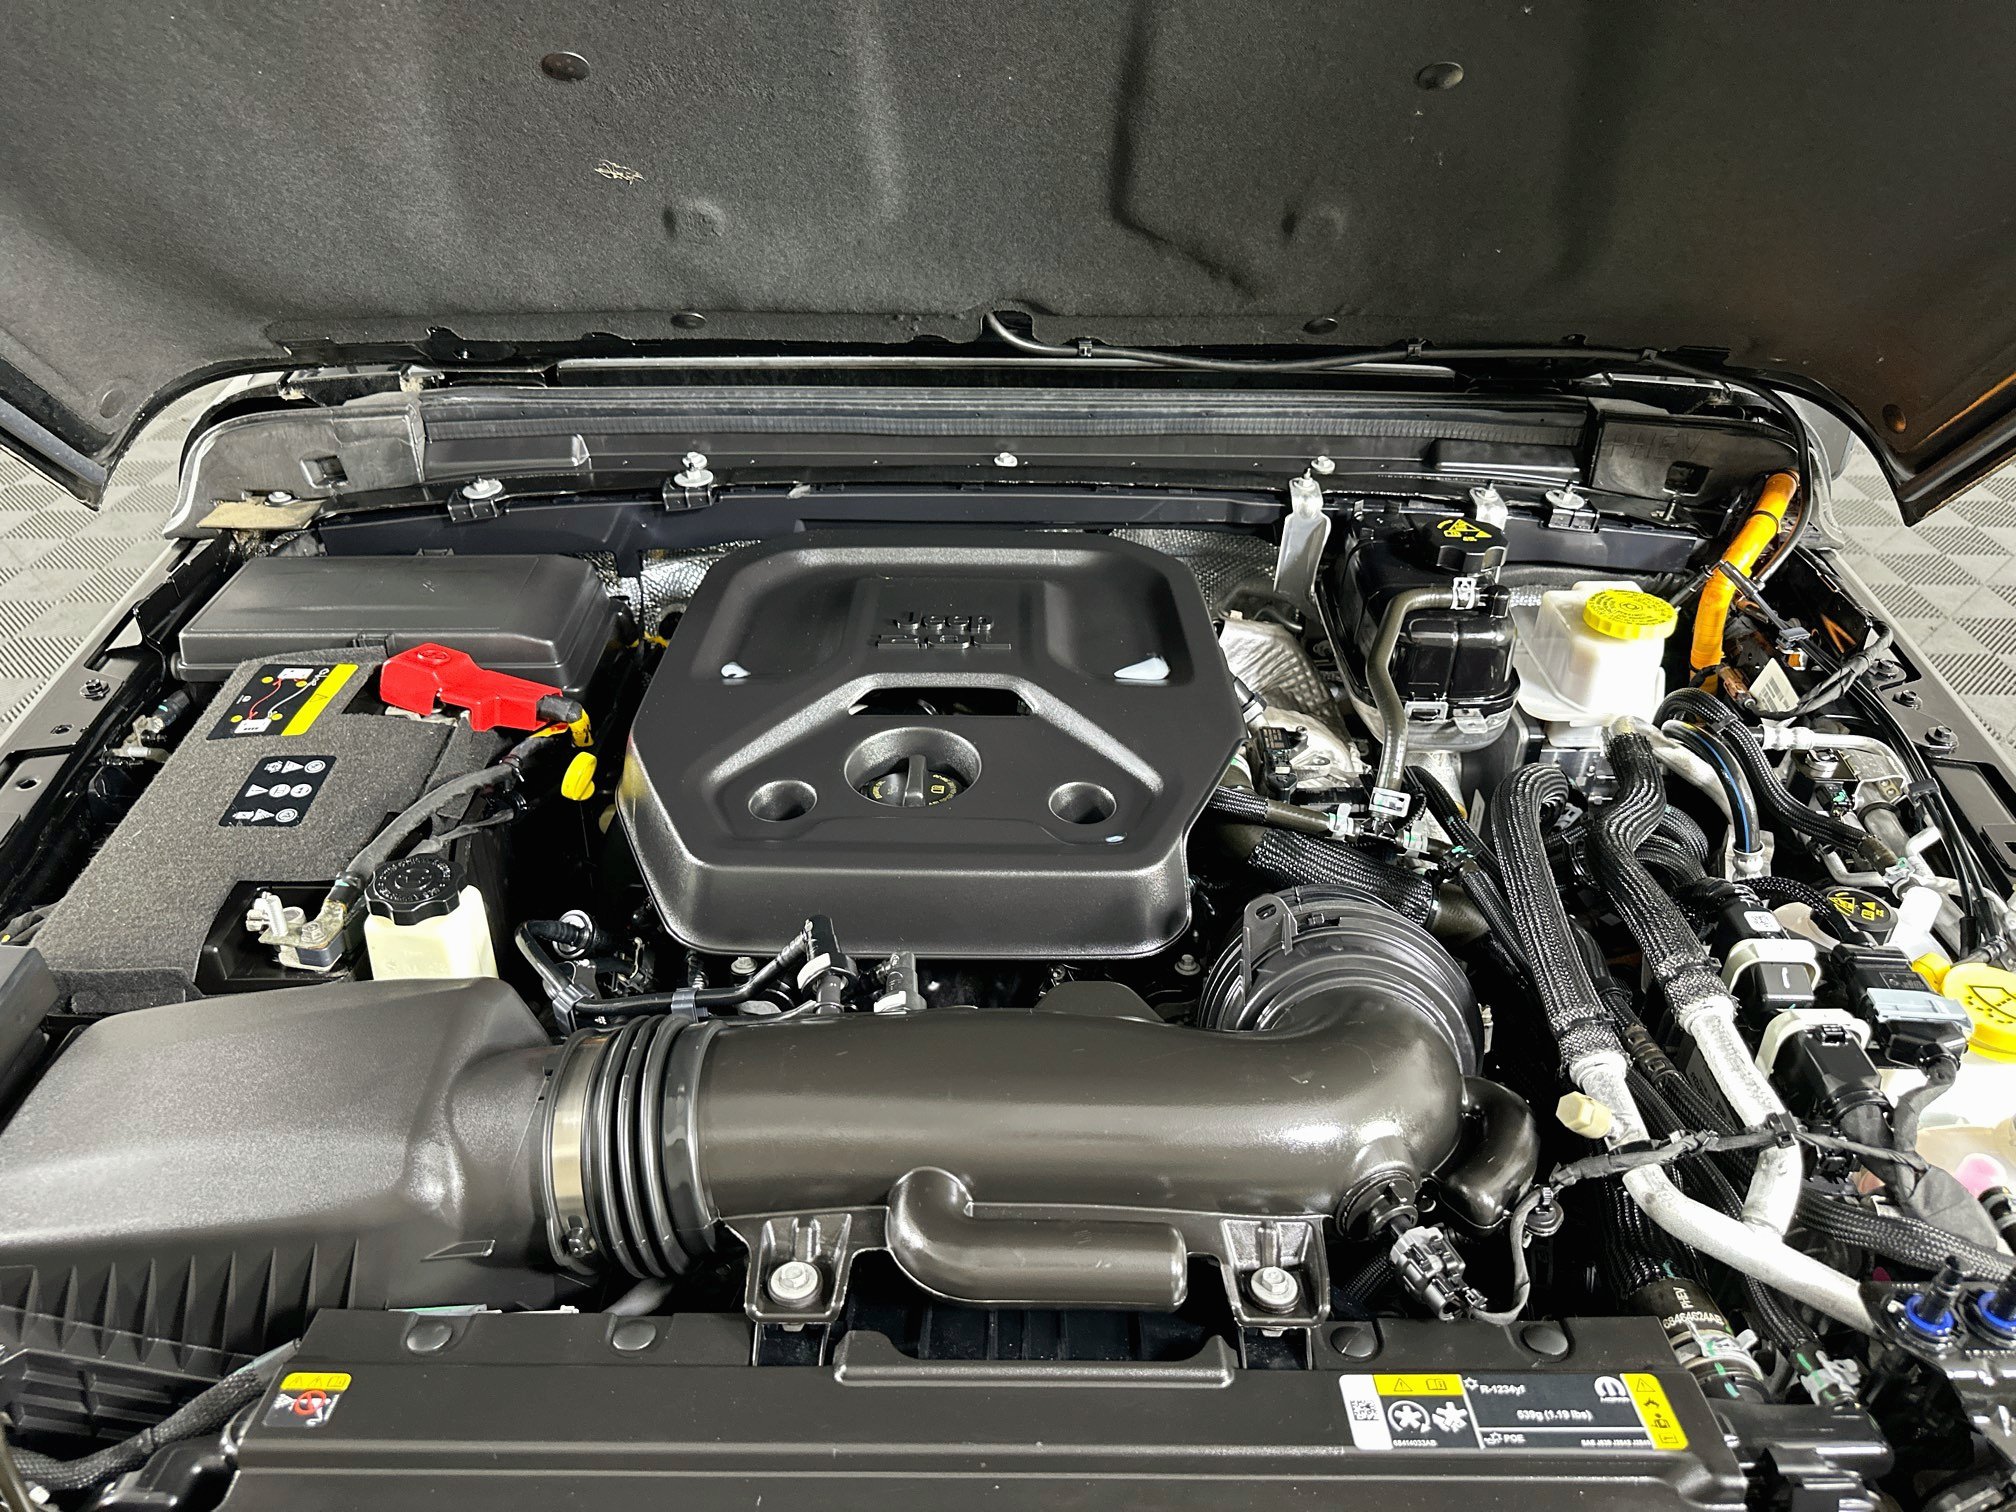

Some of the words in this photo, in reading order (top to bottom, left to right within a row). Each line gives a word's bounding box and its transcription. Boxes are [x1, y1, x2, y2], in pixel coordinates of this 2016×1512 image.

[896, 609, 995, 634] Jeep
[1673, 1286, 1694, 1309] PHEV
[1503, 1434, 1526, 1443] POE
